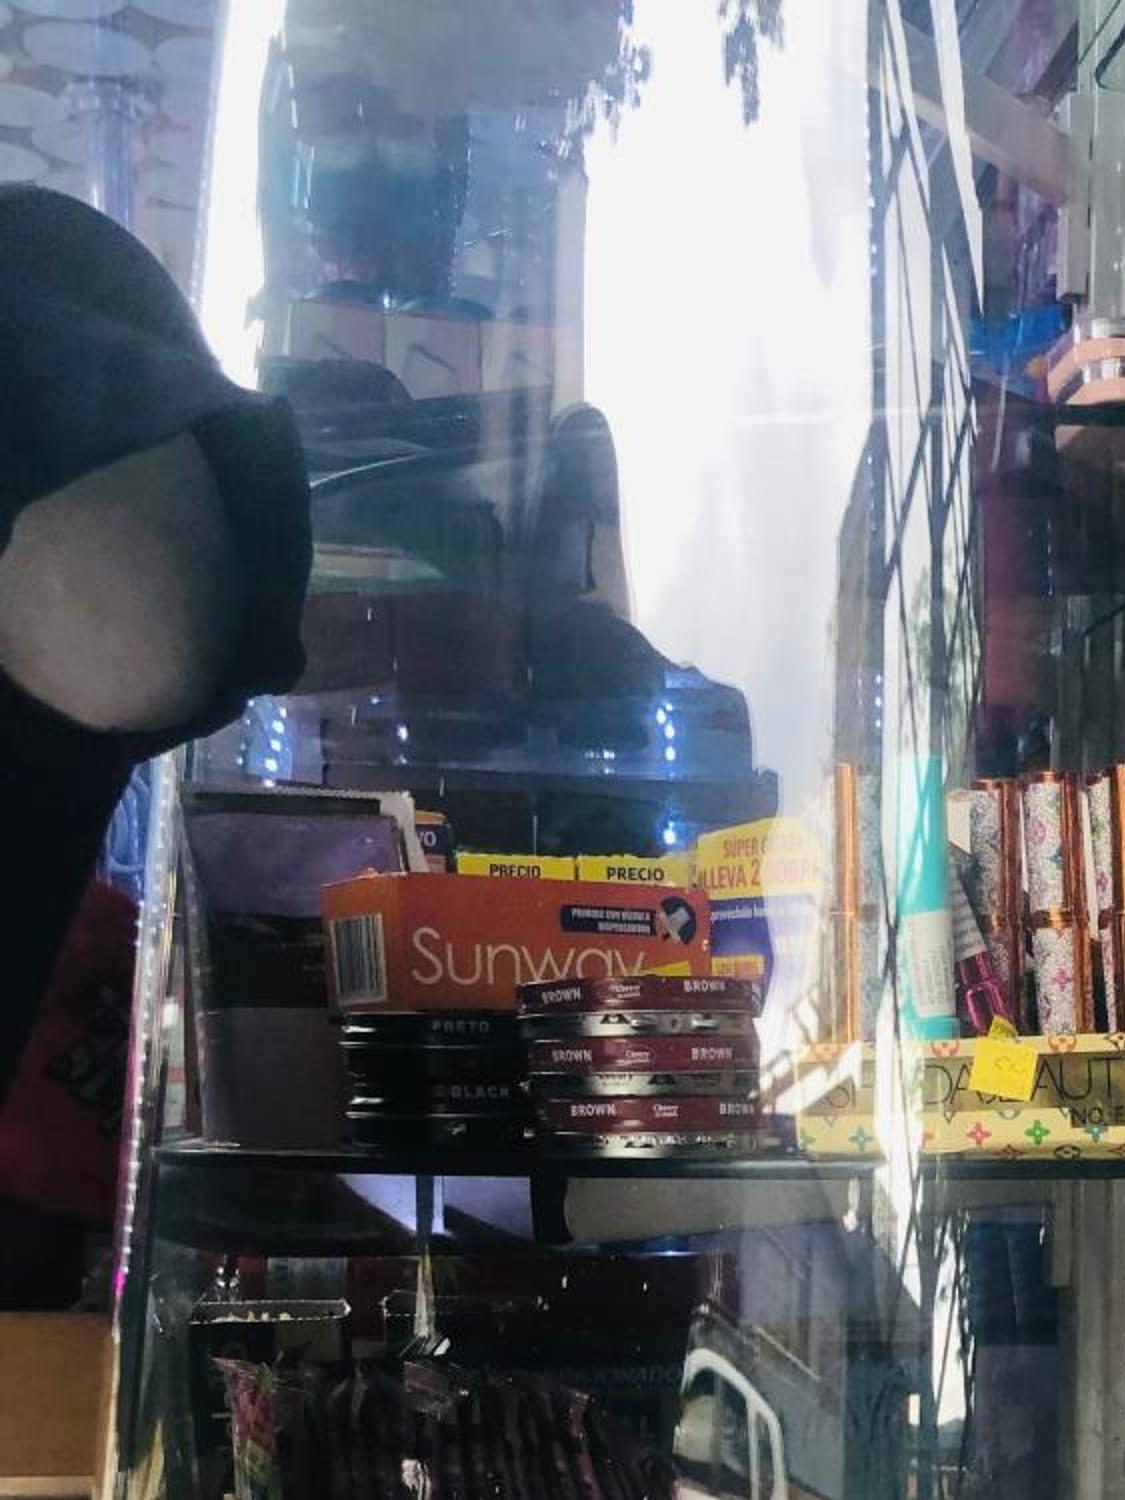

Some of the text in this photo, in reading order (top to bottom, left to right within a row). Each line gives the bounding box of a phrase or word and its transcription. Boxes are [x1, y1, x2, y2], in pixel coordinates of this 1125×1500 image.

[489, 863, 541, 878] PRECIO
[606, 866, 665, 881] PRECIO
[703, 864, 747, 890] LLEVA
[411, 926, 646, 986] Sunway
[541, 980, 726, 1005] BROWN BROWN
[552, 1046, 733, 1063] BROWN BROWN
[450, 1085, 510, 1098] BLACK
[570, 1104, 616, 1117] BROWN
